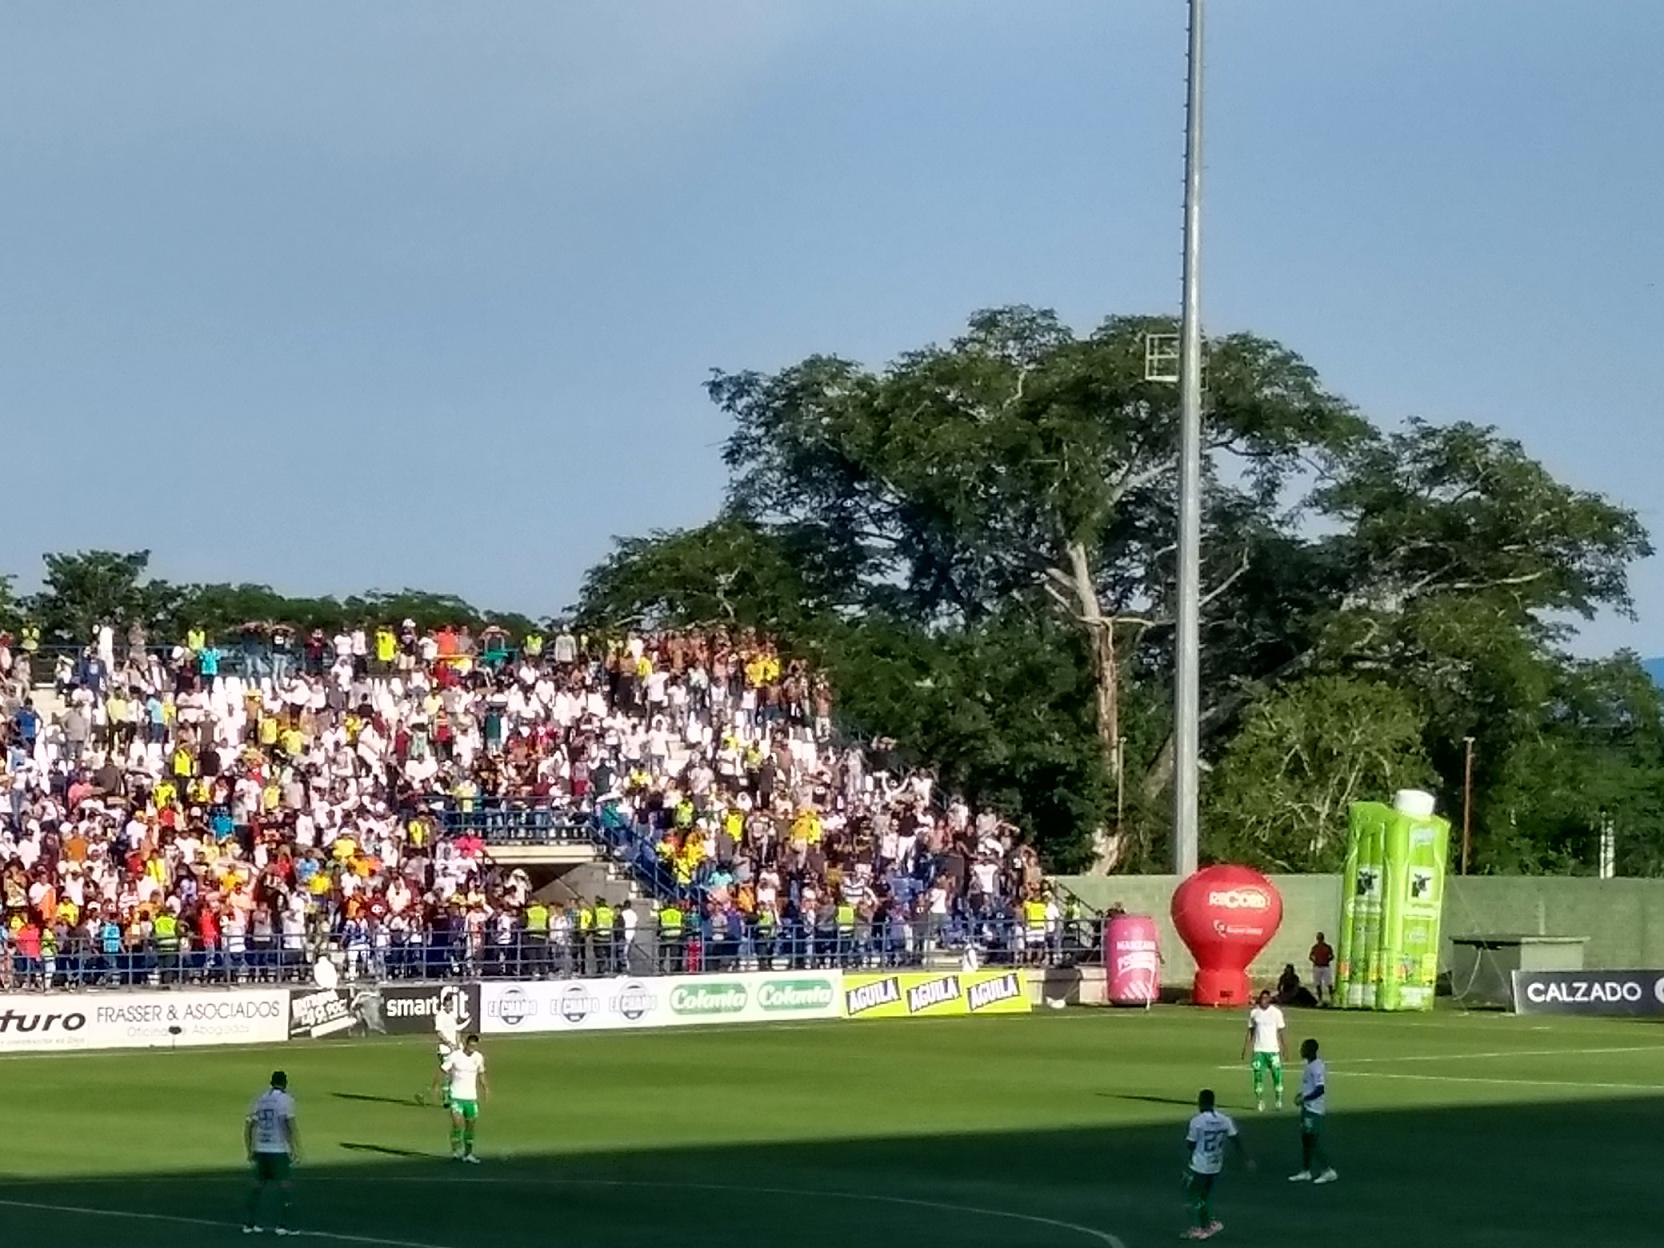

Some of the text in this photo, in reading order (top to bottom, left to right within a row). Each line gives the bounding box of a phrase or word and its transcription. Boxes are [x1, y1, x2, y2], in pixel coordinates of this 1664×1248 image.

[1527, 981, 1642, 1003] CALZADO
[97, 1005, 162, 1023] FRASSER
[166, 1003, 179, 1021] &
[184, 1000, 280, 1020] ASOCIADOS
